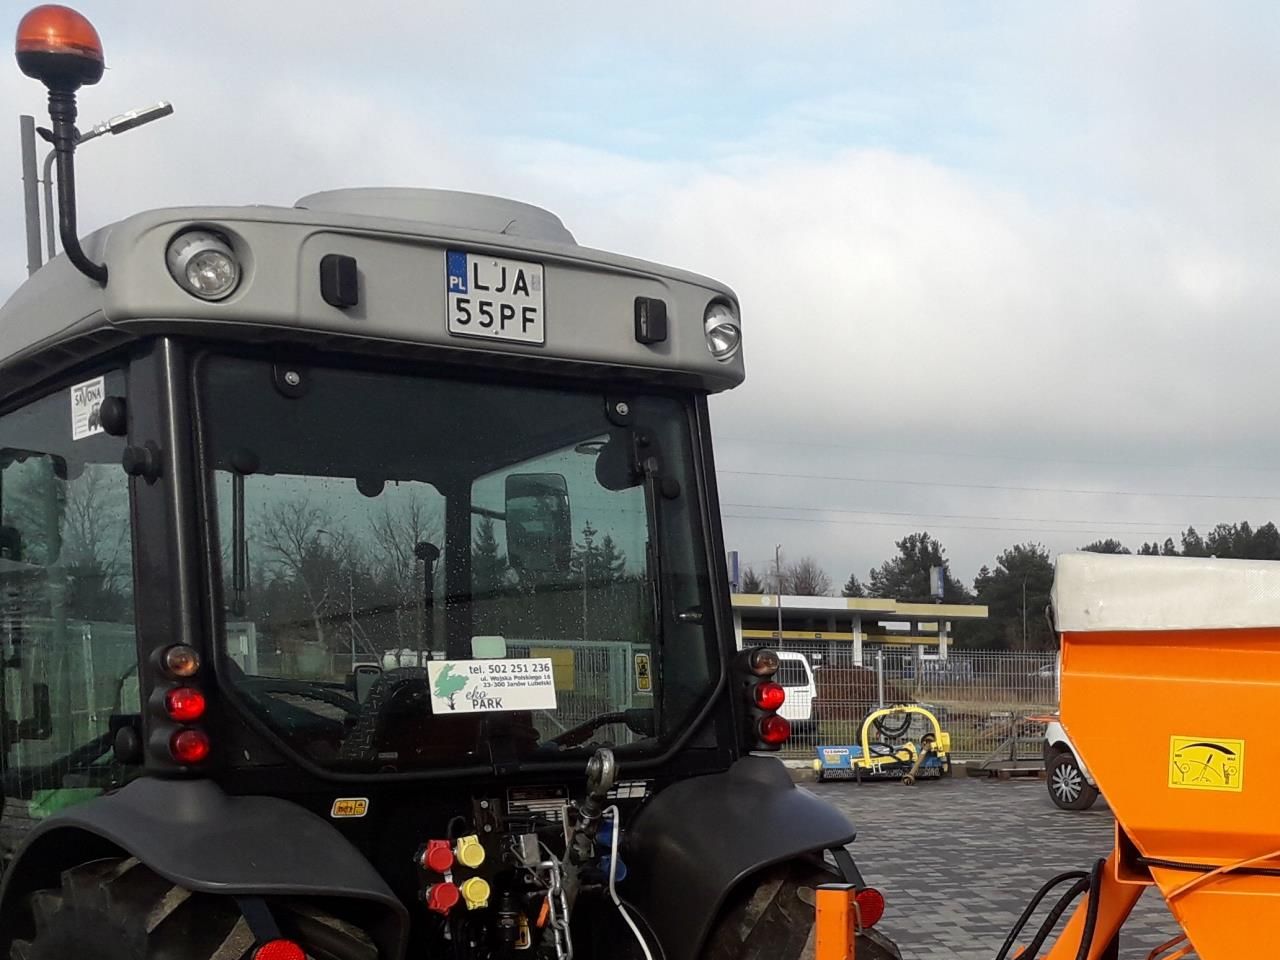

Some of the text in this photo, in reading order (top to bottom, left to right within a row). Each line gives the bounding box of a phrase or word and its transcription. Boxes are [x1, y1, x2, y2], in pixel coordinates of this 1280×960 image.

[449, 275, 466, 290] PL
[473, 262, 529, 297] LJA
[456, 297, 537, 333] 55PF
[469, 663, 550, 674] tel. 502 251 236
[466, 685, 488, 700] eko
[472, 698, 503, 709] PARK
